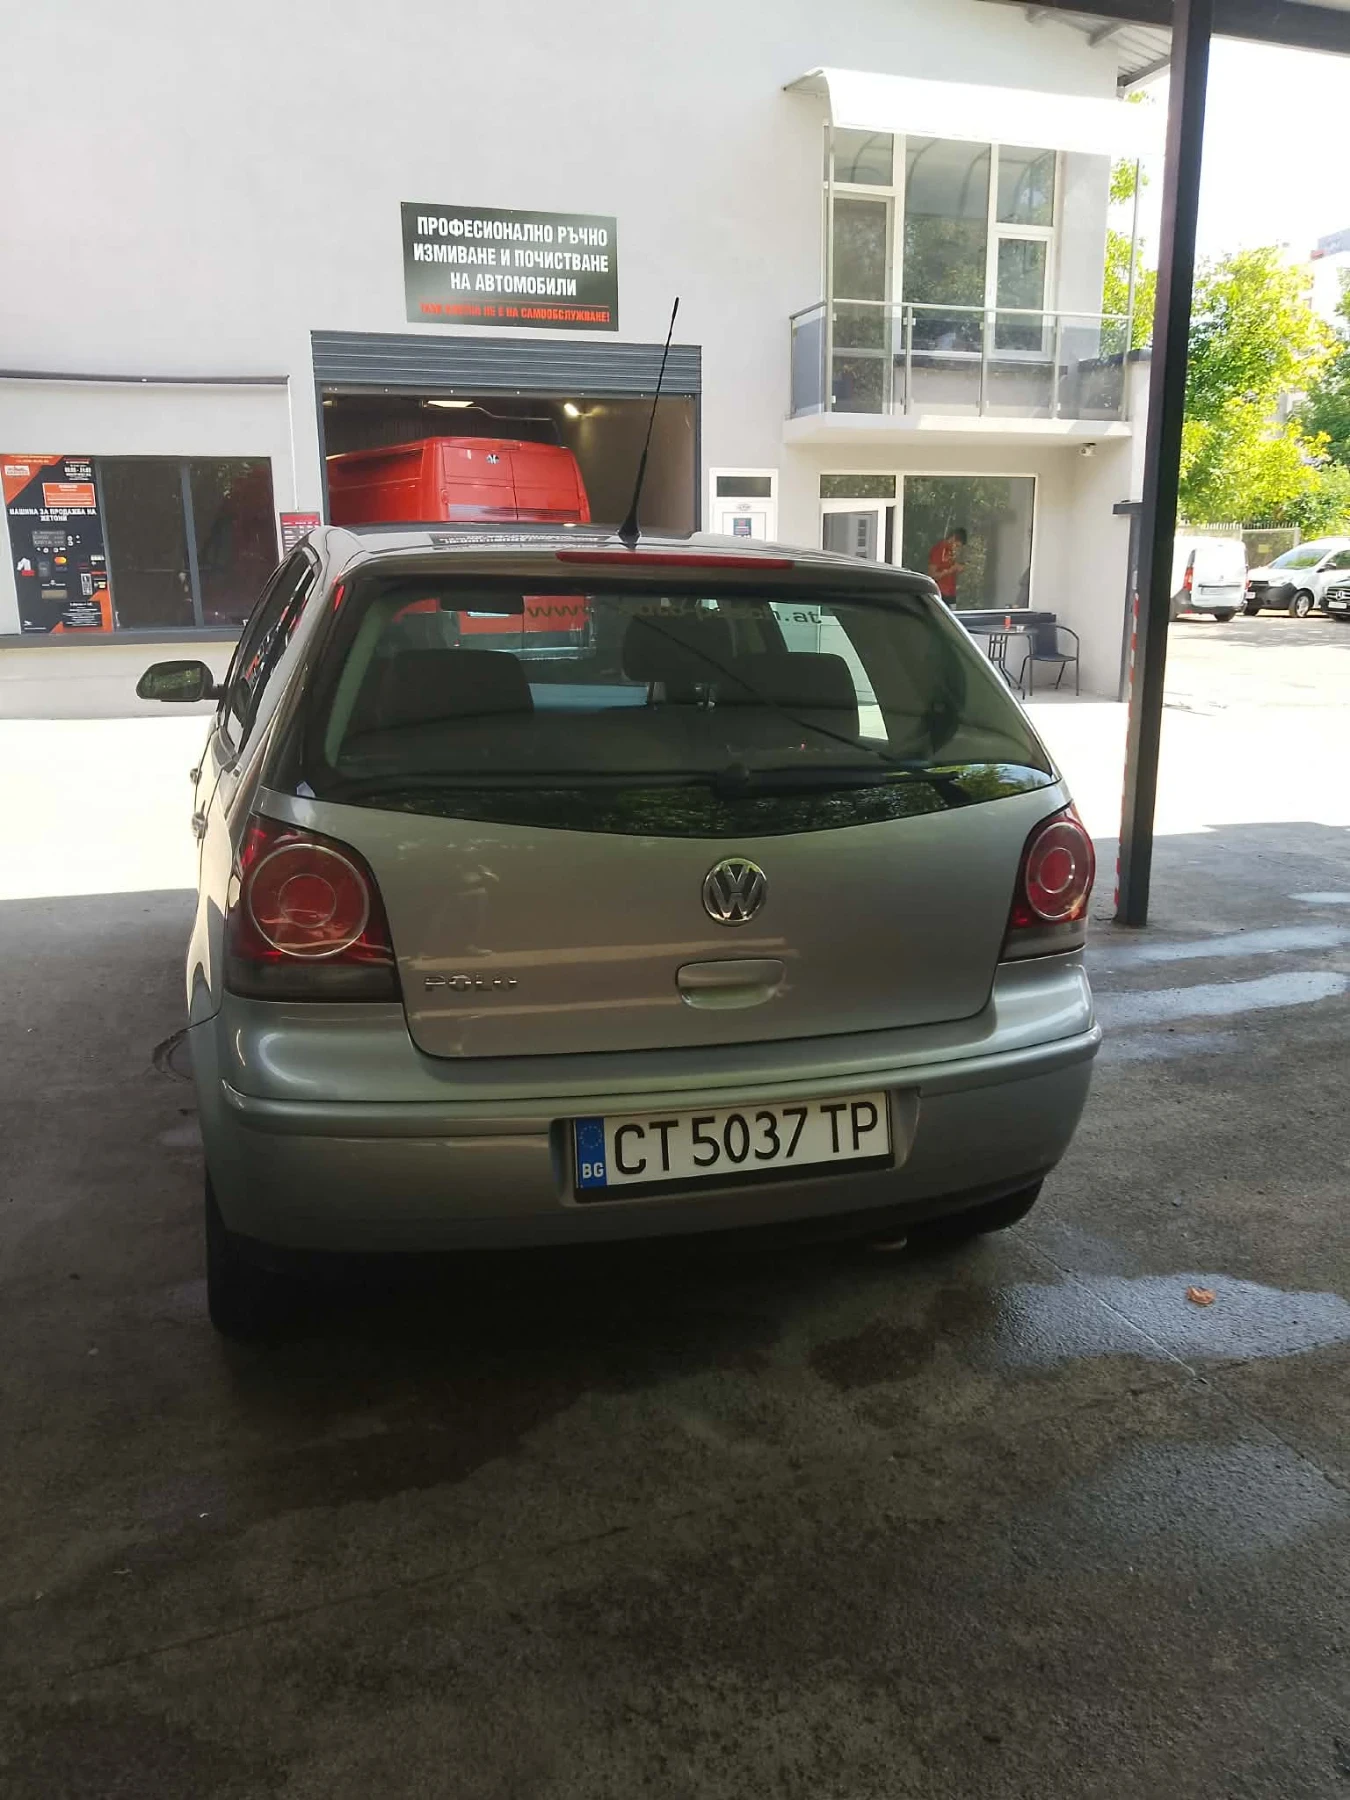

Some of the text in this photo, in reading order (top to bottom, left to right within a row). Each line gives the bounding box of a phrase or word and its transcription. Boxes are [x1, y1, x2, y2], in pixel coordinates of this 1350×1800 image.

[417, 216, 608, 246] ПРОФЕСИОНАЛНО РЪЧНО
[413, 243, 609, 272] ИЗМИВАНЕ И ПОЧИСТВАНЕ
[450, 272, 577, 296] НА АВТОМОБИЛИ
[691, 1106, 809, 1167] 5037
[582, 1162, 605, 1179] BG
